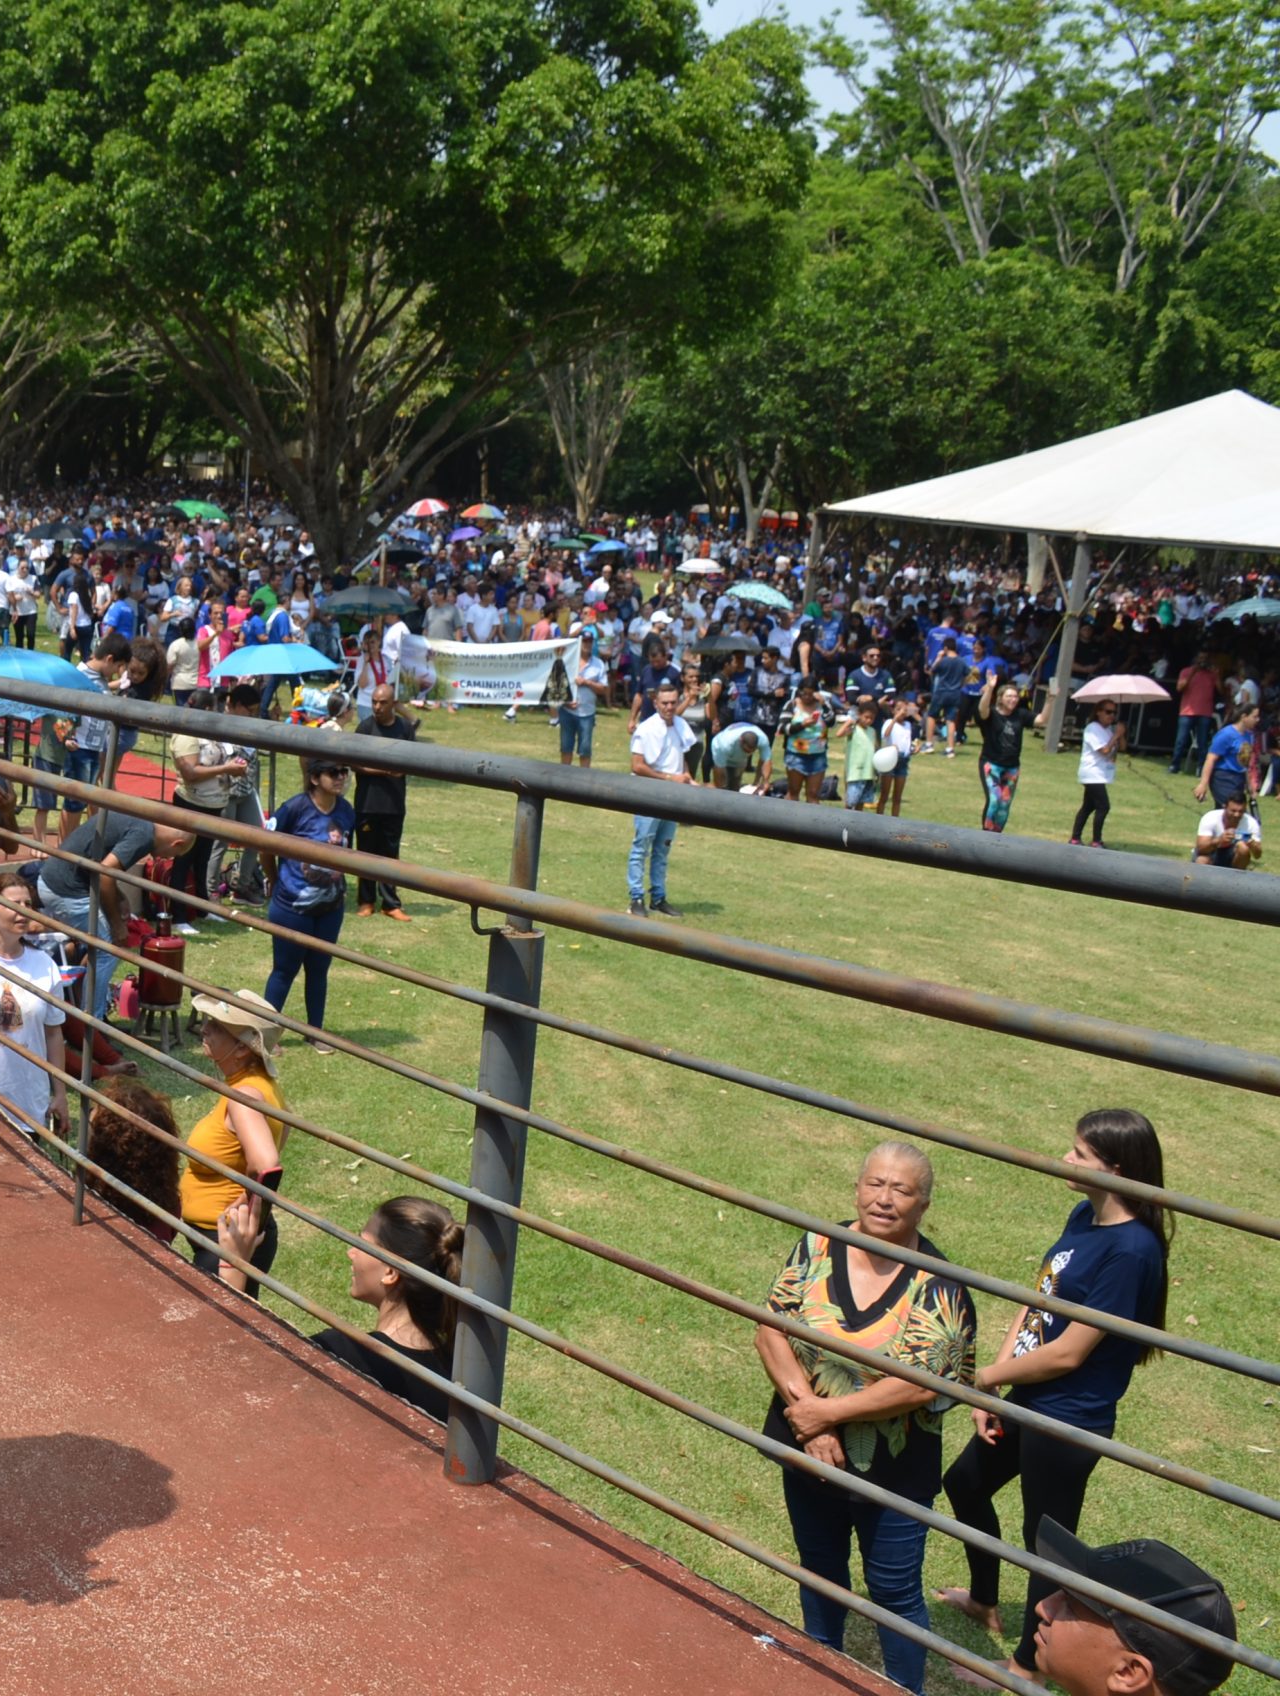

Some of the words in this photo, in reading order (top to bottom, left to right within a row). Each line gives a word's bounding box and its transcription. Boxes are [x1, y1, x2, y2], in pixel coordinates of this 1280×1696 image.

[460, 679, 523, 689] CAMINHADA
[472, 690, 492, 699] PELA
[493, 691, 512, 699] VIDA
